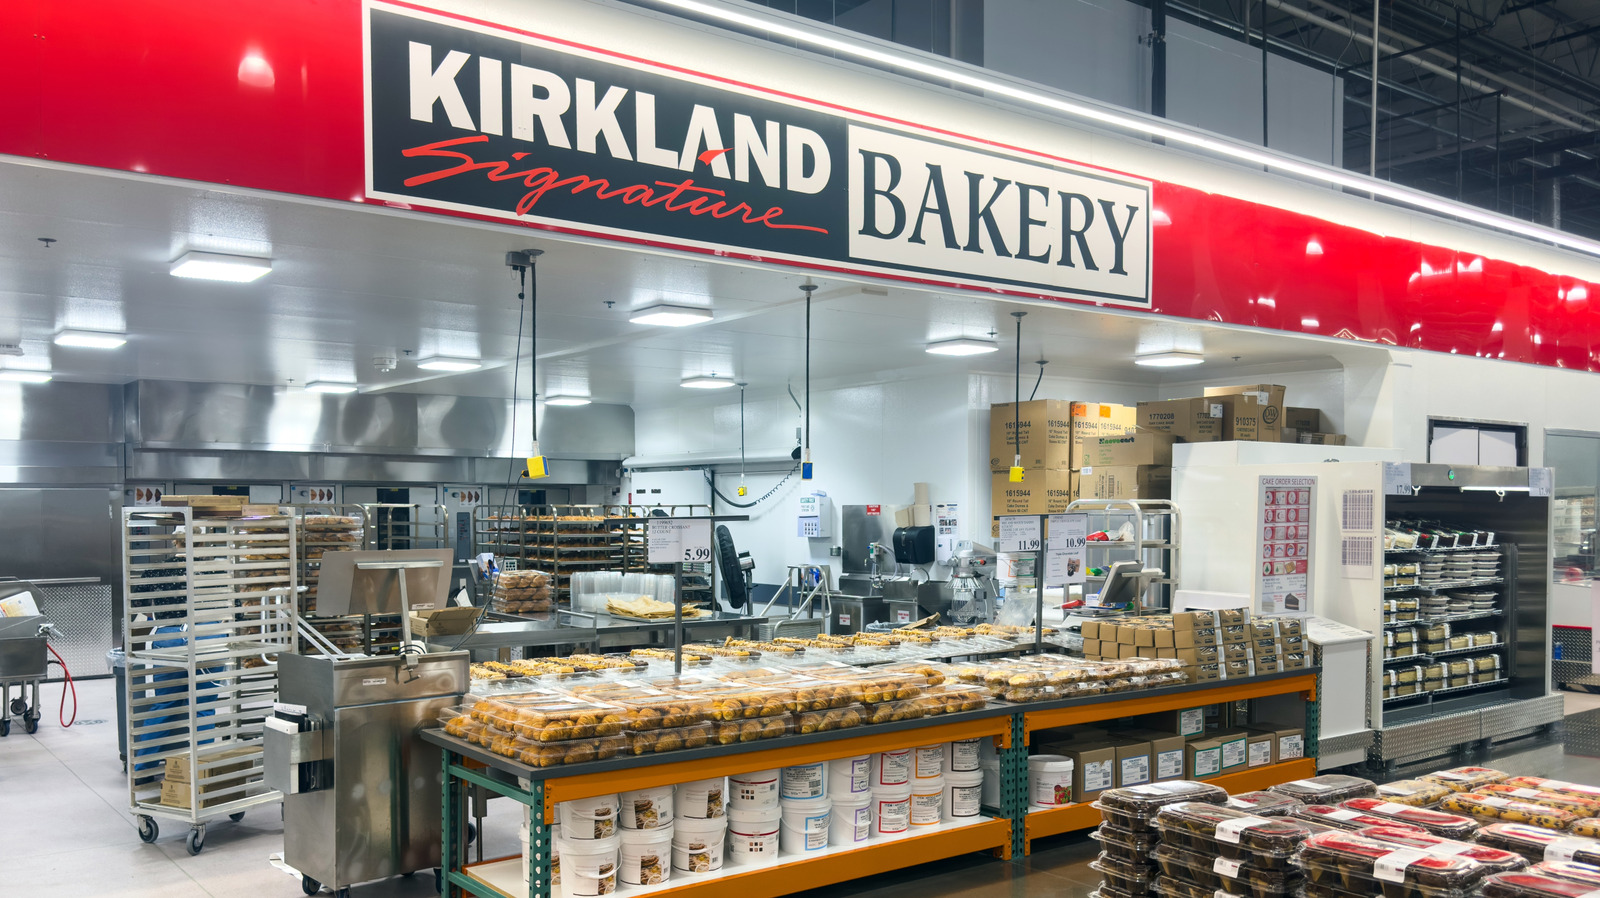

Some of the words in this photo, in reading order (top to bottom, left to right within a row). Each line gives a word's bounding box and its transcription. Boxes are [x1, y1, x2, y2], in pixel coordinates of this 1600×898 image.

[409, 40, 832, 194] KIRKLAND
[402, 136, 828, 234] Signature
[858, 148, 1138, 276] BAKERY
[1236, 417, 1256, 426] 910375
[1396, 485, 1410, 494] 17.99
[1018, 540, 1040, 550] 11.99
[1066, 538, 1085, 547] 10.99
[684, 549, 710, 560] 5.99
